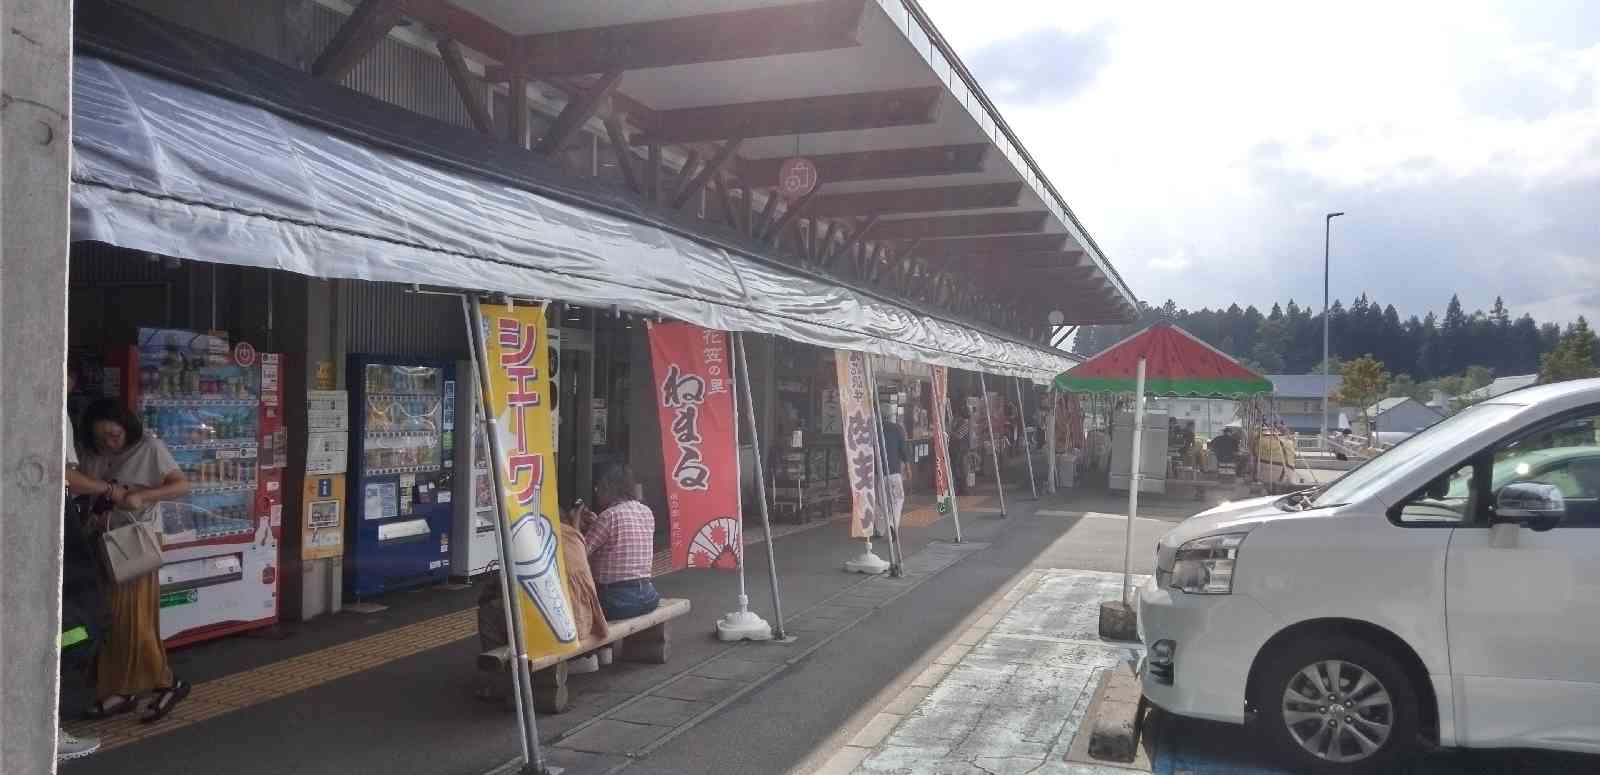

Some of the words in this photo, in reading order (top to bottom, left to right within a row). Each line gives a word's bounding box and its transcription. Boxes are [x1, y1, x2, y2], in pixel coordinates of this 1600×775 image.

[499, 317, 543, 504] シェーク
[661, 364, 709, 490] ねまる
